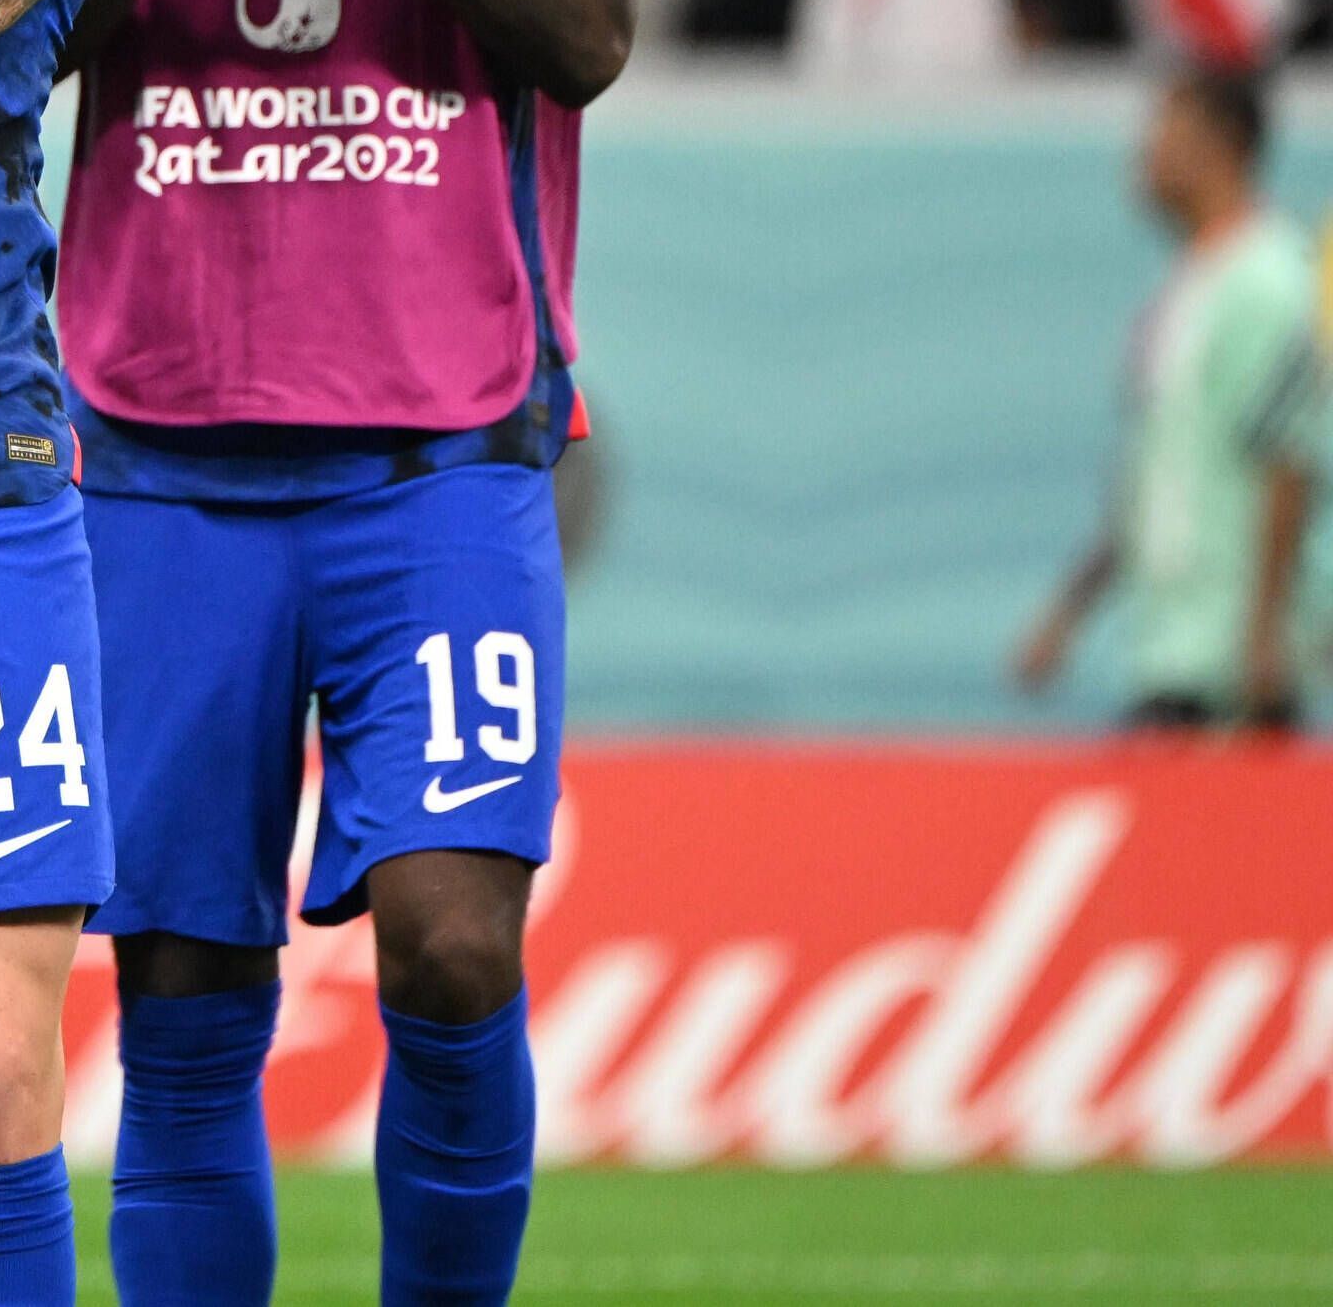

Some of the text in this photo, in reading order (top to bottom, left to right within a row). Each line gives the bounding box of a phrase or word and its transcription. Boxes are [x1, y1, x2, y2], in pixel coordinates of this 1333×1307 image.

[202, 85, 380, 128] WORLD
[386, 88, 466, 131] CUP
[415, 632, 536, 764] 19
